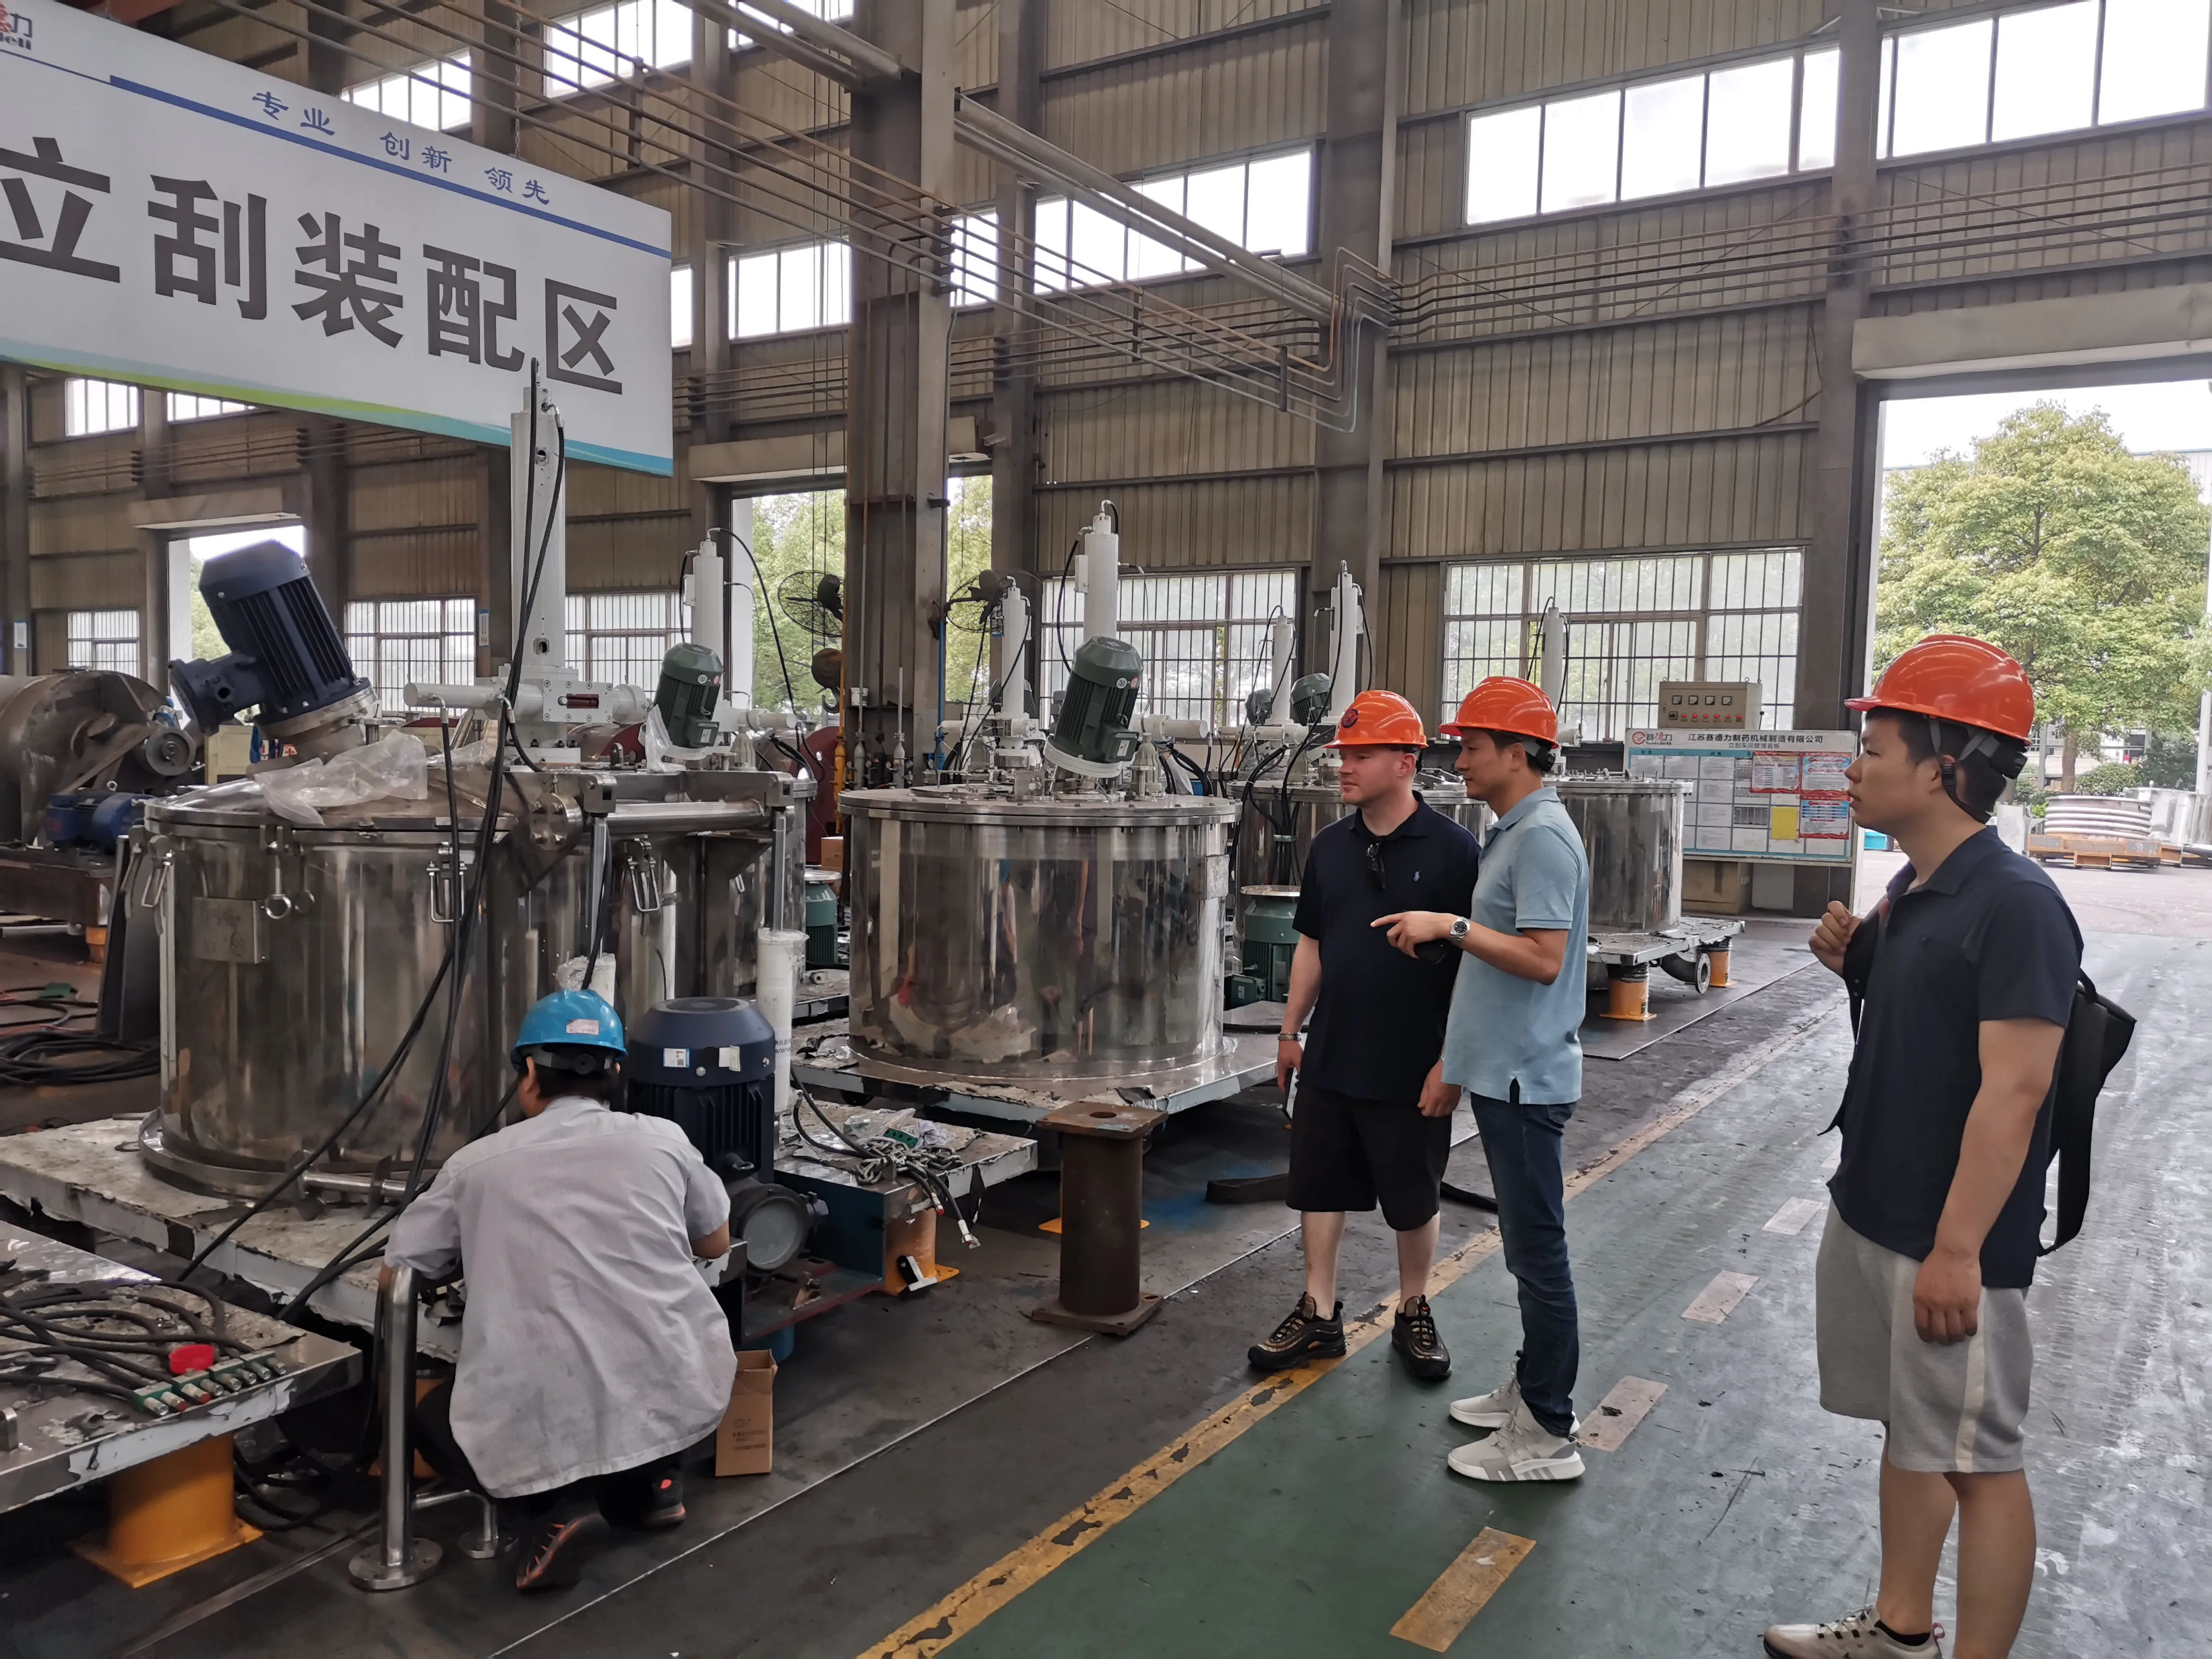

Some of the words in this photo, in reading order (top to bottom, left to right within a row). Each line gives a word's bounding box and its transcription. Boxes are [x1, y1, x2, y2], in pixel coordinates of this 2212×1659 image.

[252, 91, 335, 136] 专业
[380, 132, 452, 173] 创新
[484, 166, 550, 205] 领先
[0, 136, 623, 395] 立刮装配区
[1688, 734, 1823, 743] 江苏赛德力制药机械制造有限公司
